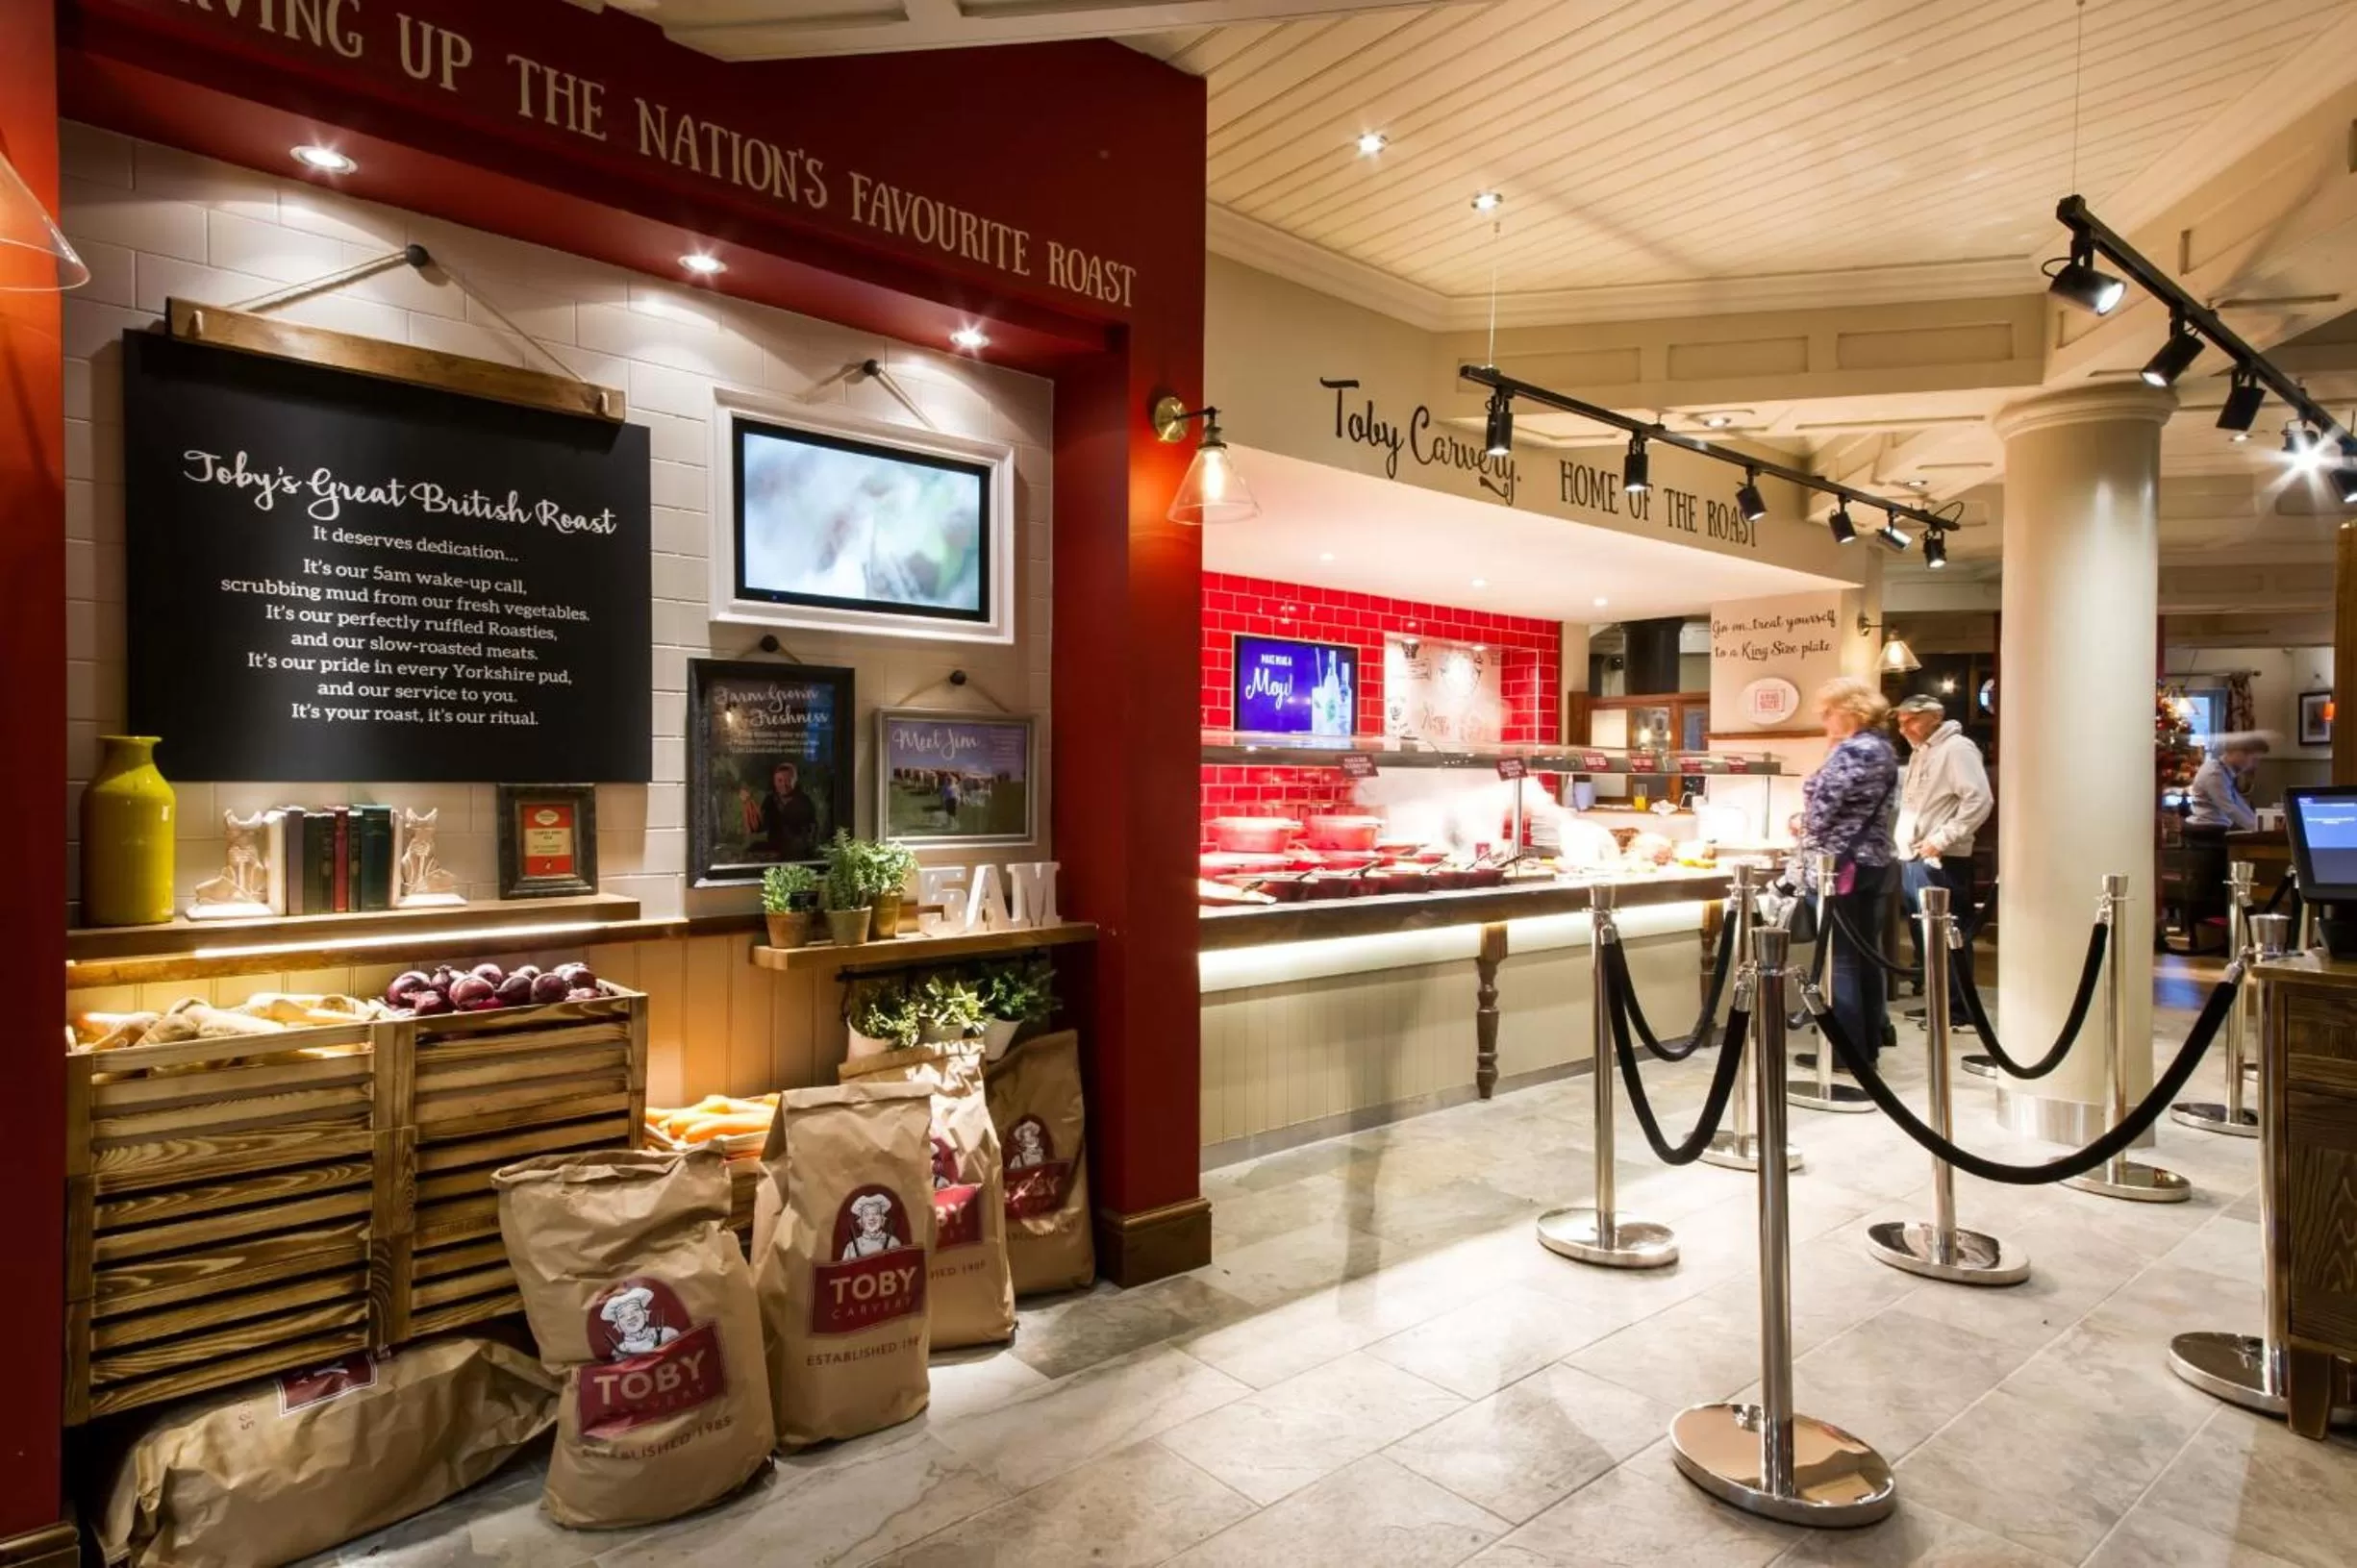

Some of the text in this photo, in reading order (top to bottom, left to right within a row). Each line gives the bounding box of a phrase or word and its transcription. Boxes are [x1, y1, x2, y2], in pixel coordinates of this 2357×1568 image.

[396, 12, 472, 91] UP
[507, 54, 608, 141] THE
[634, 97, 828, 209] NATION'S
[848, 171, 1031, 276] FAVOURITE
[1046, 240, 1137, 308] ROAST
[1319, 376, 1405, 480] Toby
[1560, 460, 1619, 515] HOME
[1628, 483, 1654, 522] OF
[1664, 488, 1698, 534] THE
[1707, 500, 1757, 548] ROAST
[183, 450, 617, 535] Toby's Great British Roast
[313, 525, 519, 562] It deserves dedication...
[303, 558, 528, 596] It's our 5am wake-up call,
[220, 579, 321, 602] scrubbing
[326, 587, 369, 604] mud
[372, 589, 418, 607] from
[421, 595, 453, 610] our
[457, 596, 500, 614] fresh
[264, 604, 558, 642] It's our perfectly ruffled Roasties,
[1712, 620, 1729, 639] Go
[1786, 610, 1837, 634] yourself
[290, 632, 539, 660] and our slow-roasted meats.
[1715, 645, 1727, 659] to
[1742, 640, 1768, 661] King
[1770, 640, 1798, 656] Size
[1801, 638, 1833, 660] plate
[247, 651, 573, 685] It's our pride in every Yorkshire pud,
[317, 681, 518, 703] and our service to you.
[291, 703, 539, 726] It's your roast, it's our ritual.
[750, 706, 829, 727] Freshness
[892, 728, 941, 752] Meet
[941, 728, 979, 760] Jim
[829, 1266, 917, 1305] TOBY
[593, 1349, 705, 1406] TOBY
